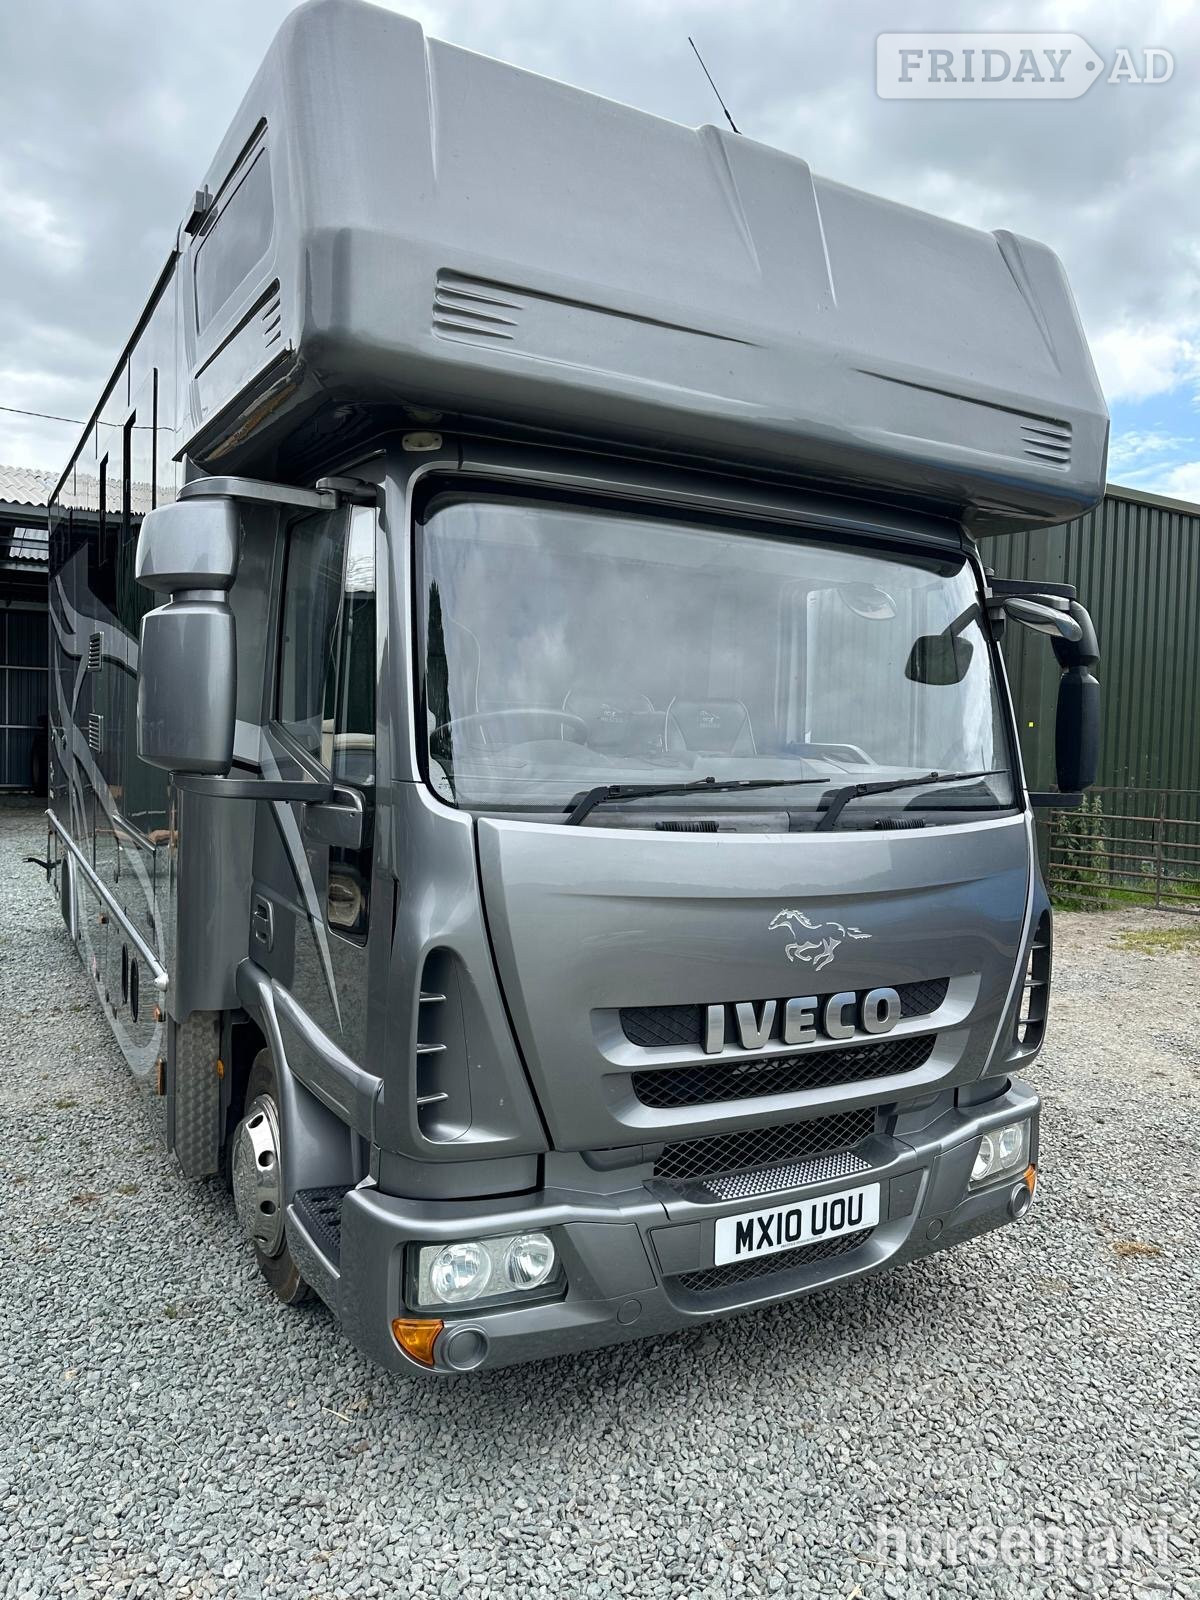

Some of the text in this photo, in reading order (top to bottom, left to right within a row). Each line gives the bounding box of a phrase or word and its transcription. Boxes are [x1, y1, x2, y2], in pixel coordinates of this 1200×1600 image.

[704, 987, 901, 1055] IVECO
[735, 1193, 863, 1255] MX10 UOU
